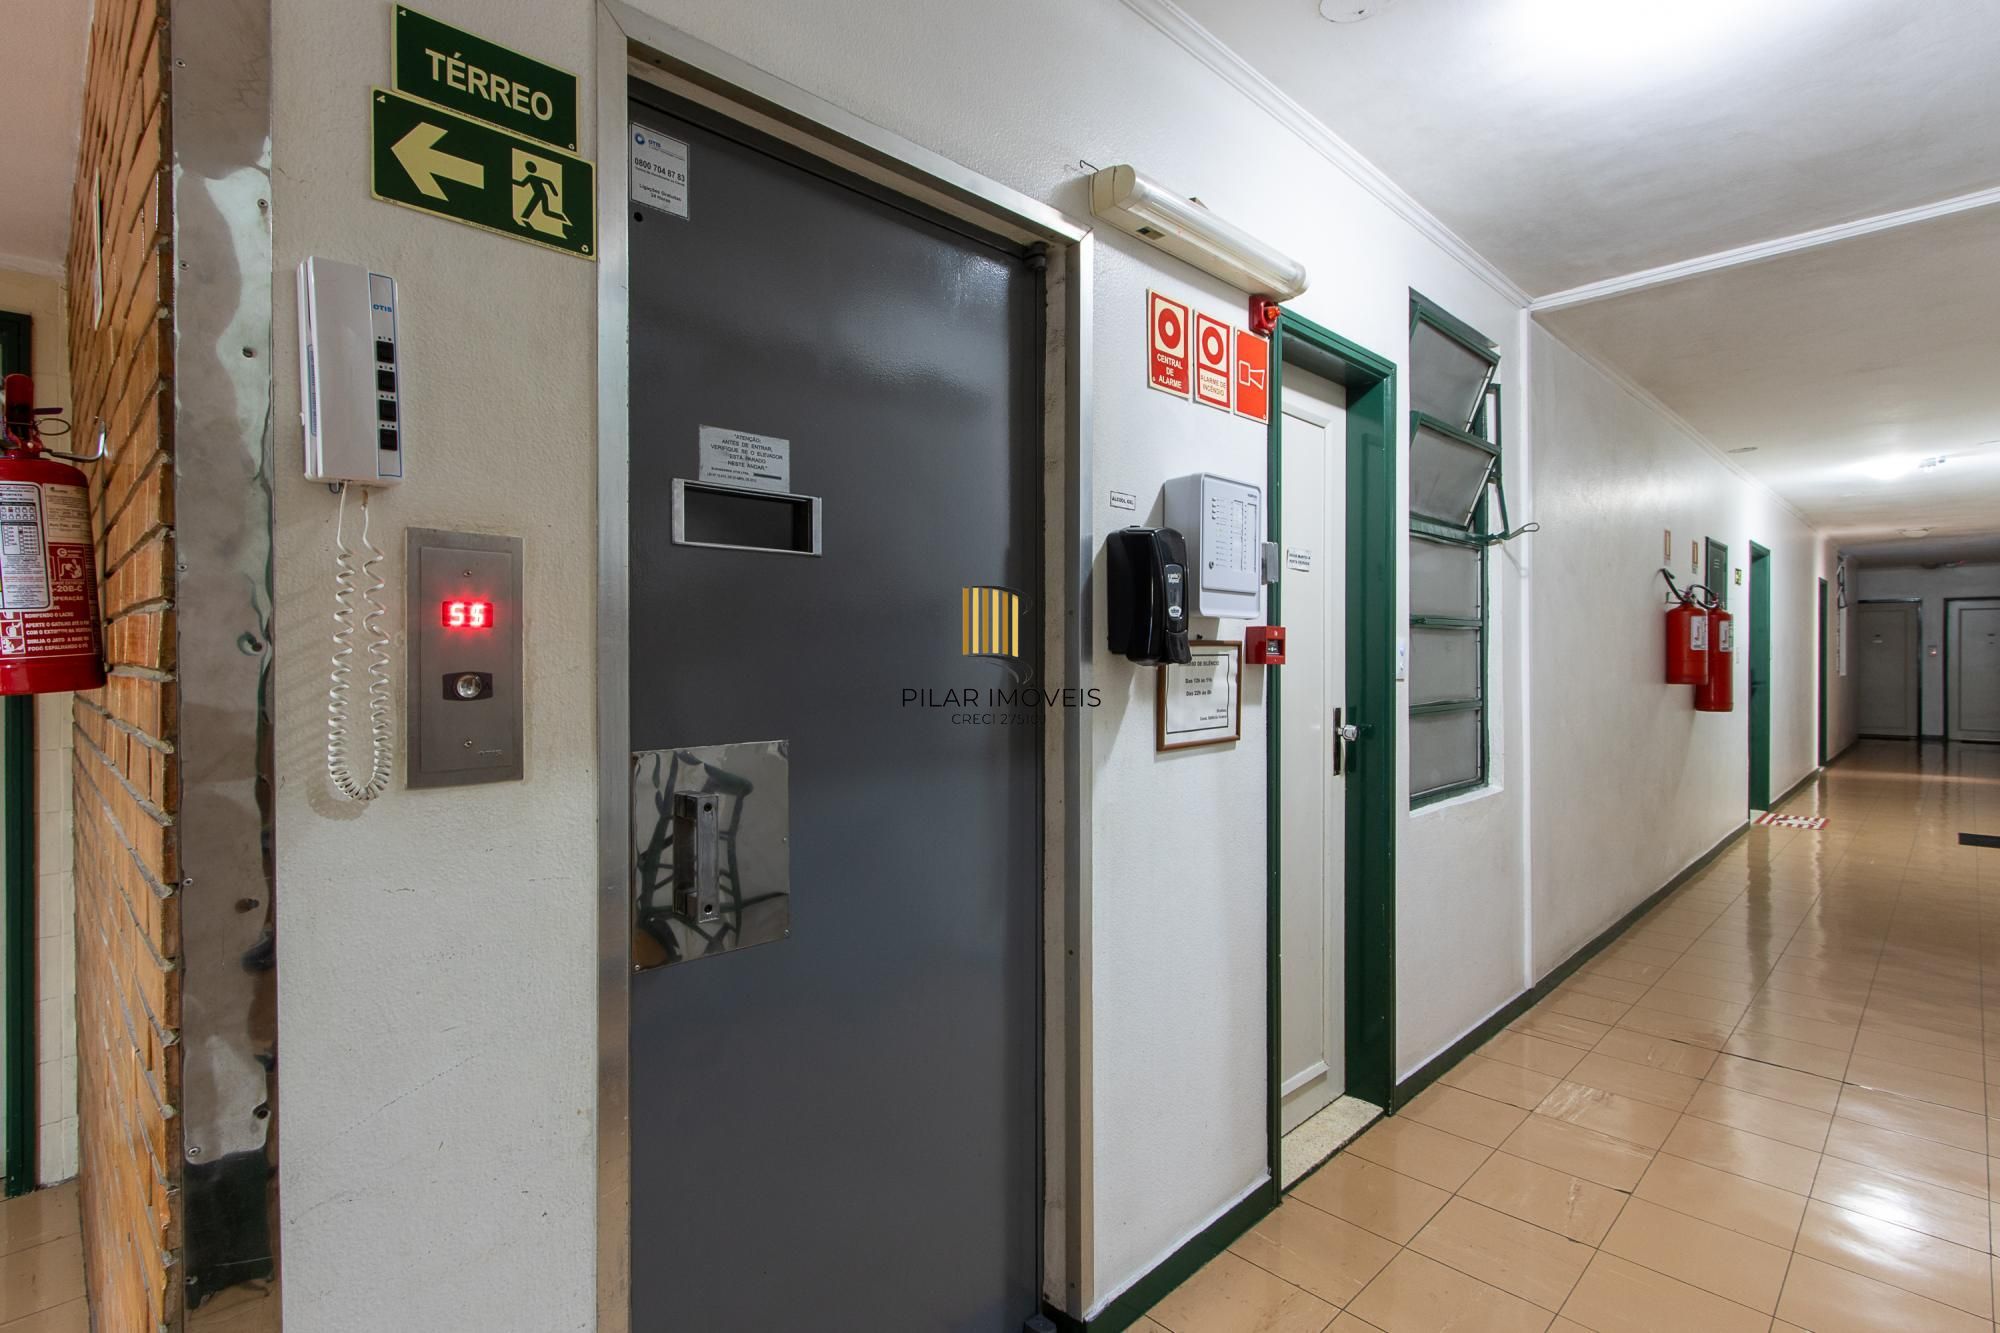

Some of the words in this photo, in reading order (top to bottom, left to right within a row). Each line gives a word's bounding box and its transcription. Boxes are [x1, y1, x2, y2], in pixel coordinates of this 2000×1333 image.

[425, 48, 553, 121] TÉRREO
[373, 303, 393, 313] OTIS
[1156, 353, 1184, 370] CENTRAL
[1165, 366, 1175, 377] DE
[1158, 374, 1183, 390] ALARME
[1200, 374, 1219, 387] ALARME
[721, 439, 740, 447] ANTES
